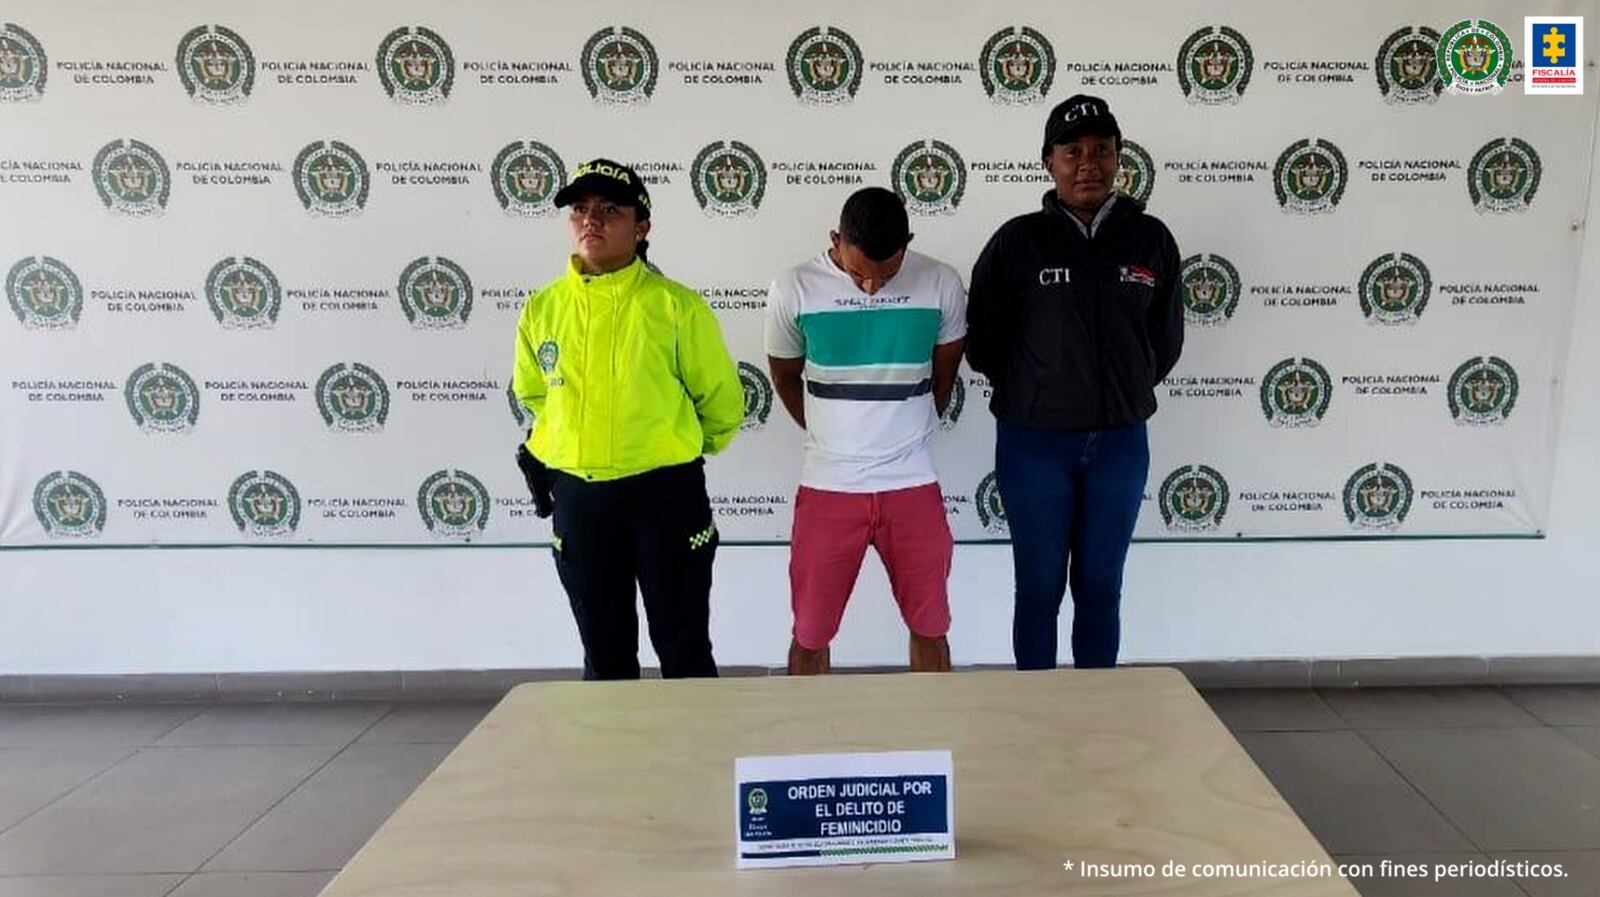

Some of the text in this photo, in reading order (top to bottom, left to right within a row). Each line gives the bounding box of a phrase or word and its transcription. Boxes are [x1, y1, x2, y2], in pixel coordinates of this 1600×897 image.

[74, 74, 90, 84] DE
[277, 75, 293, 84] DE
[480, 75, 495, 84] DE
[684, 75, 699, 84] DE
[885, 75, 899, 84] DE
[1082, 76, 1097, 85] DE
[1277, 74, 1292, 83] DE
[1064, 102, 1099, 122] CTI
[193, 175, 208, 184] DE
[392, 176, 407, 184] DE
[787, 175, 802, 184] DE
[985, 175, 1000, 183] DE
[1179, 174, 1193, 183] DE
[1372, 173, 1386, 181] DE
[1039, 268, 1070, 285] CTI
[725, 289, 768, 298] NACION
[1264, 298, 1279, 306] DE
[1452, 296, 1466, 305] DE
[108, 303, 123, 312] DE
[303, 302, 316, 310] DE
[497, 301, 511, 310] DE
[1163, 376, 1198, 386] OLICÍA
[1169, 388, 1183, 397] DE
[1356, 386, 1370, 395] DE
[29, 393, 43, 401] DE
[221, 393, 235, 401] DE
[412, 392, 426, 401] DE
[788, 781, 932, 800] ORDEN JUDICIAL POR
[815, 800, 905, 817] EL DELITO DE
[820, 819, 901, 836] FEMINICIDIO
